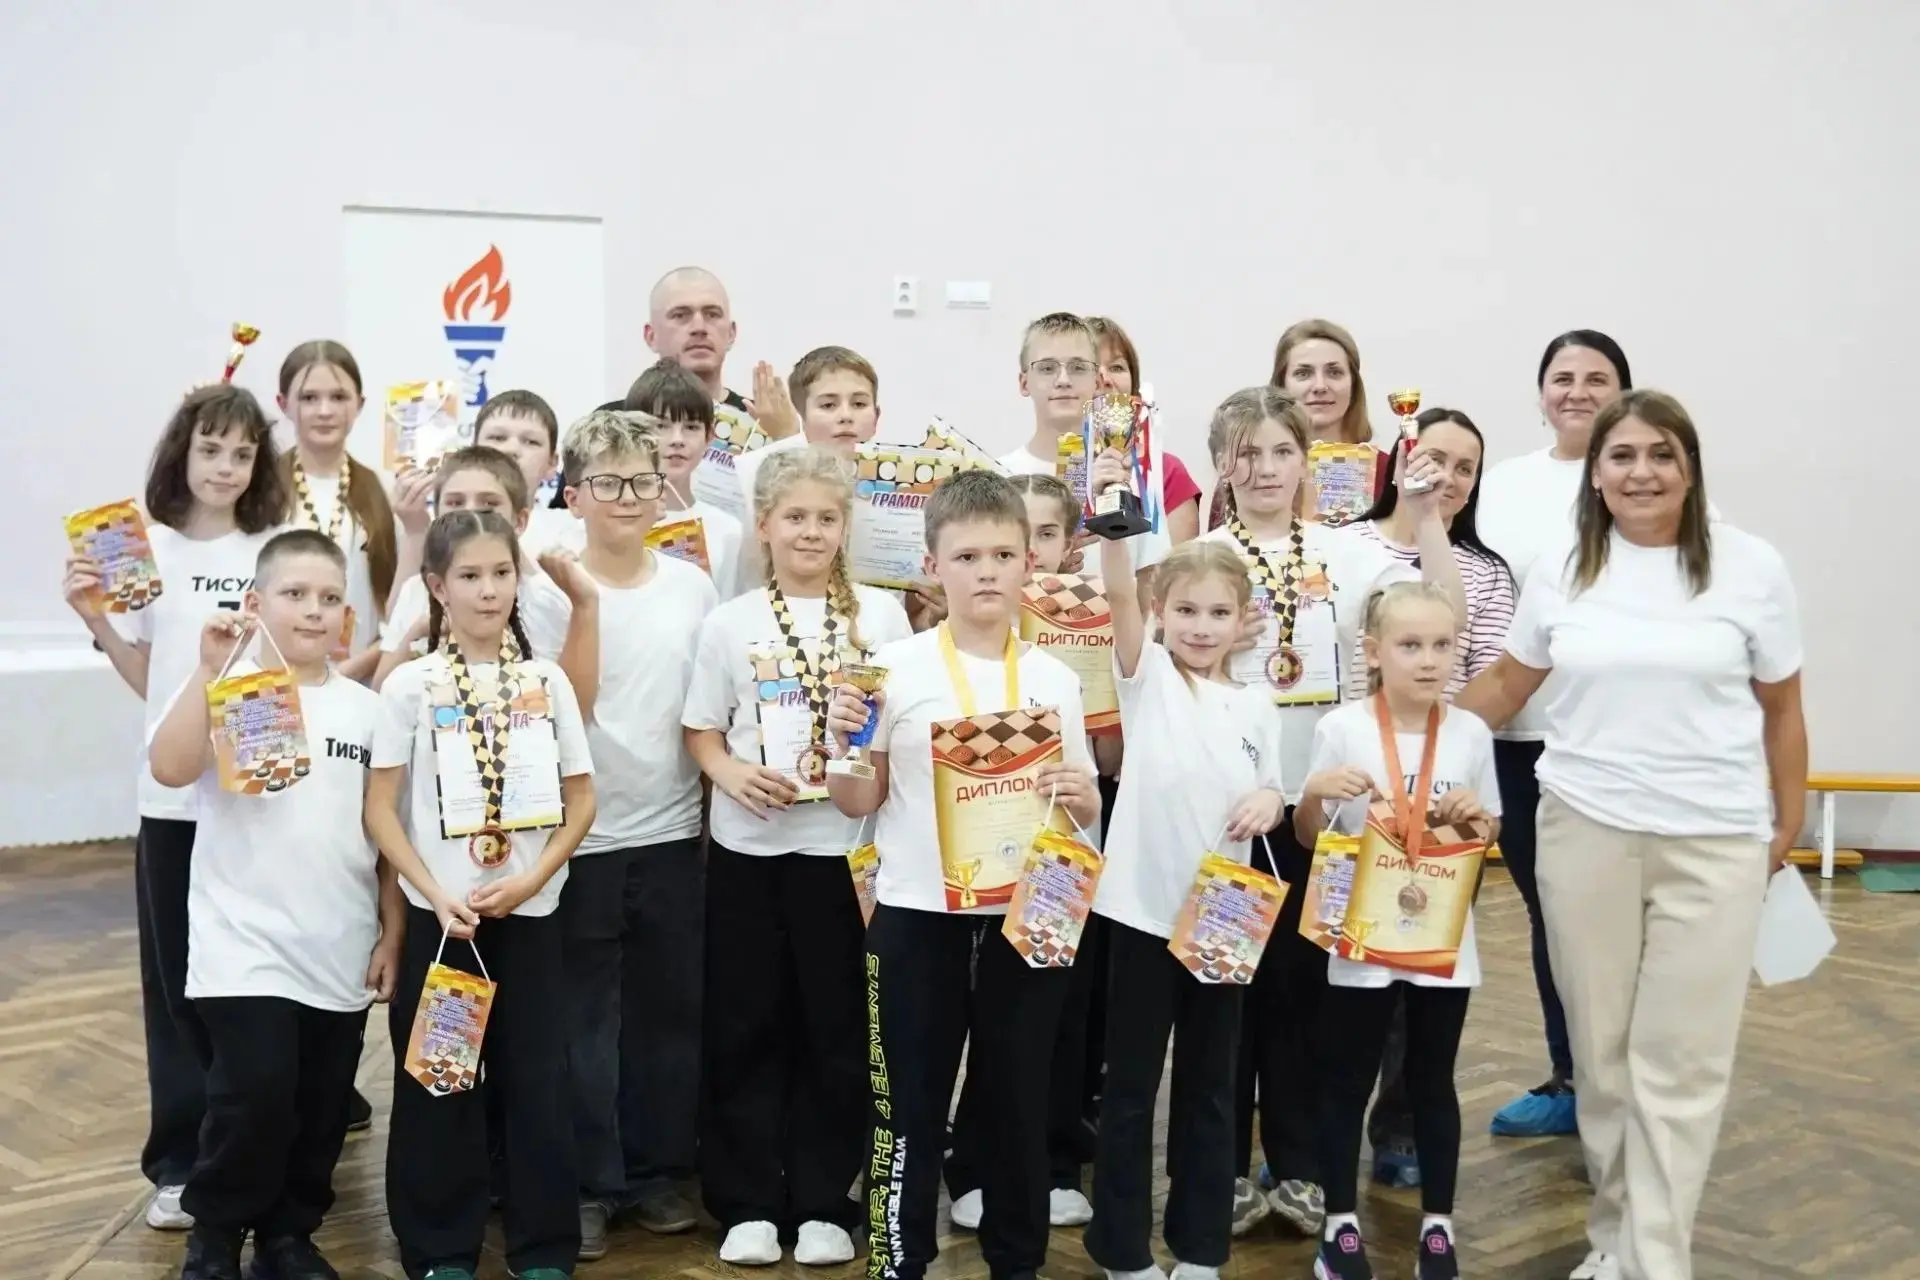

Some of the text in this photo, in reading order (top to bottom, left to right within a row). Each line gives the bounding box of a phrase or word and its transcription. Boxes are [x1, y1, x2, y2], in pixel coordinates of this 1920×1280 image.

[1037, 632, 1113, 646] ДИПЛОМ
[866, 952, 890, 1097] ELEMENTS
[875, 1098, 891, 1120] 4
[871, 1126, 893, 1180] THE
